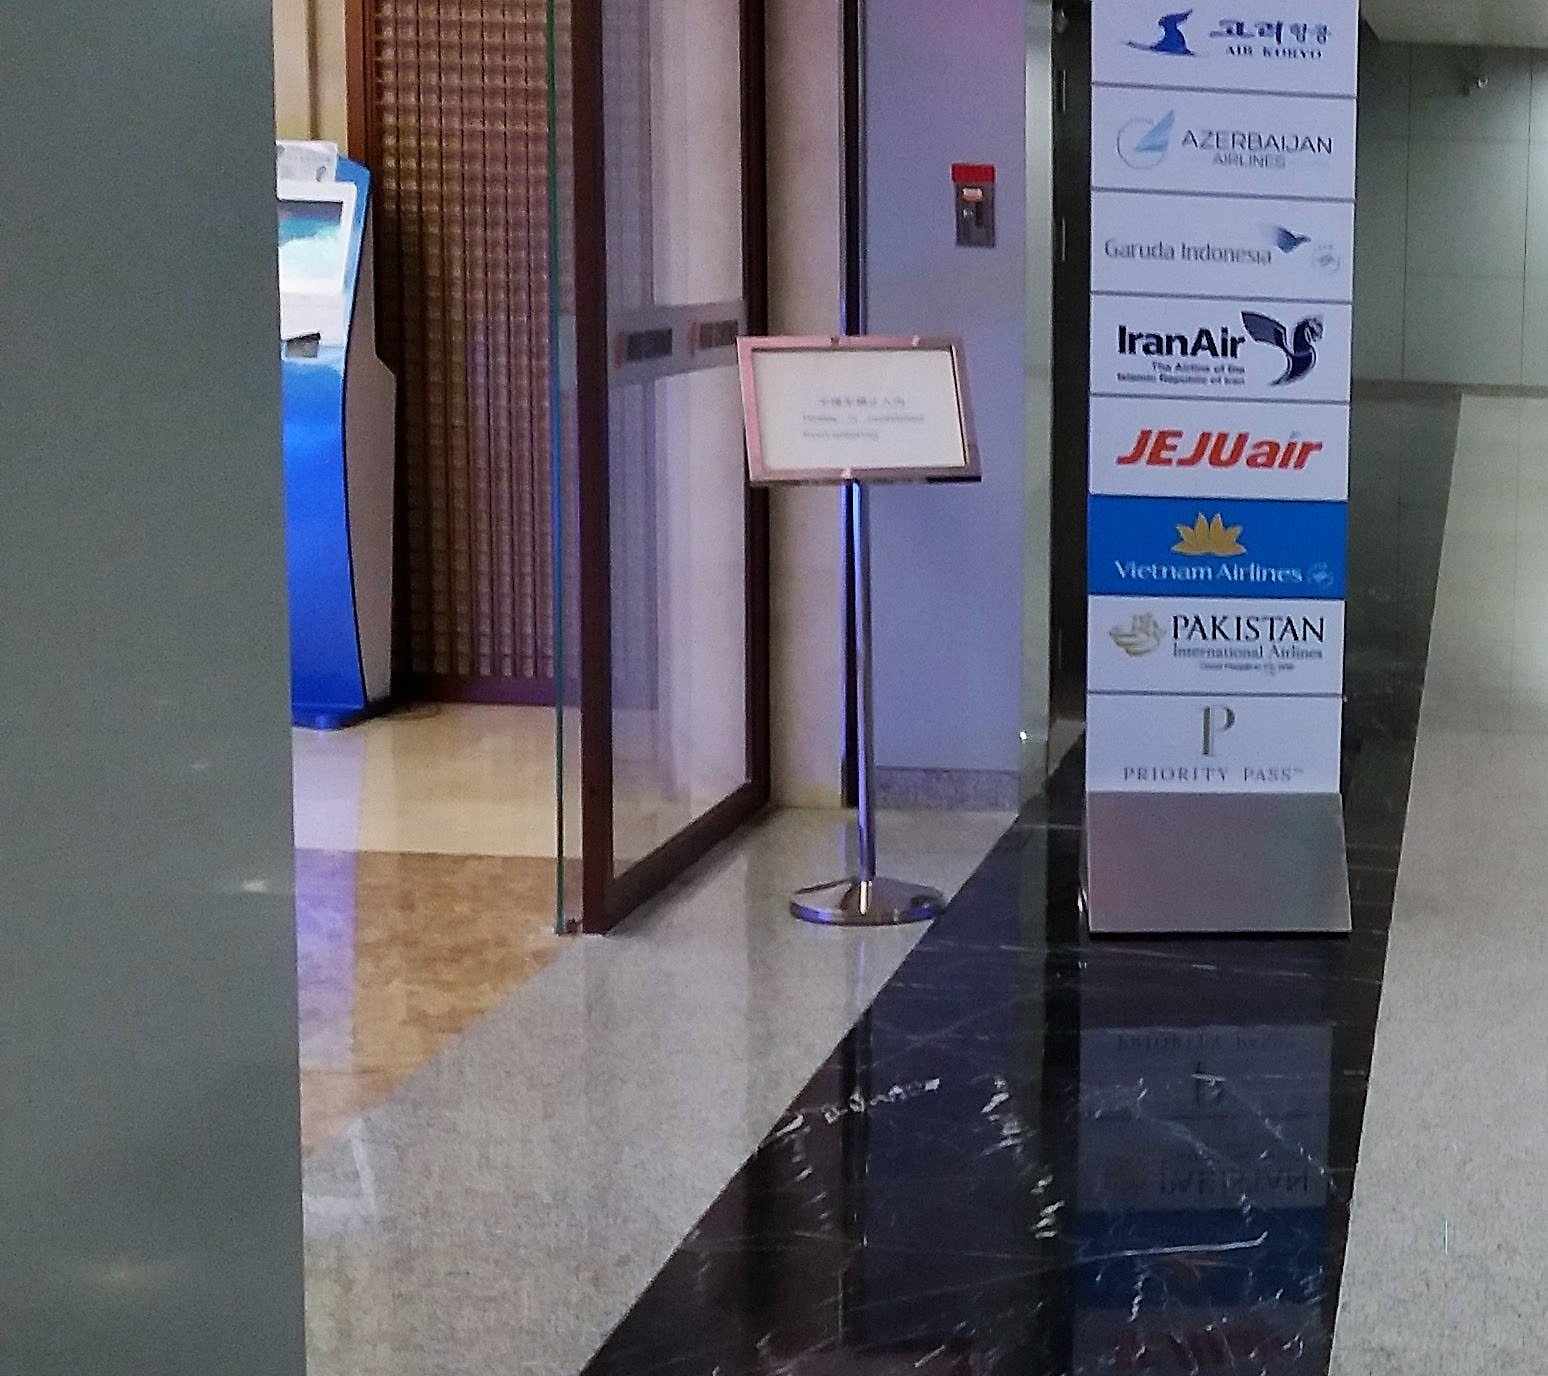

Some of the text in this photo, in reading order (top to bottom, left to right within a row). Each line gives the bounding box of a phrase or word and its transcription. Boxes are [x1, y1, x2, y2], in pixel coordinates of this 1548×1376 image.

[1181, 129, 1332, 155] AZERBAIJAN
[1213, 154, 1286, 169] AIRLINES
[1105, 238, 1272, 265] Garuda Indonesia
[1115, 560, 1303, 583] Vietnam Airlines
[1172, 614, 1325, 643] PAKISTAN
[1173, 643, 1323, 660] International Airlines
[1124, 767, 1229, 782] PRIORITY
